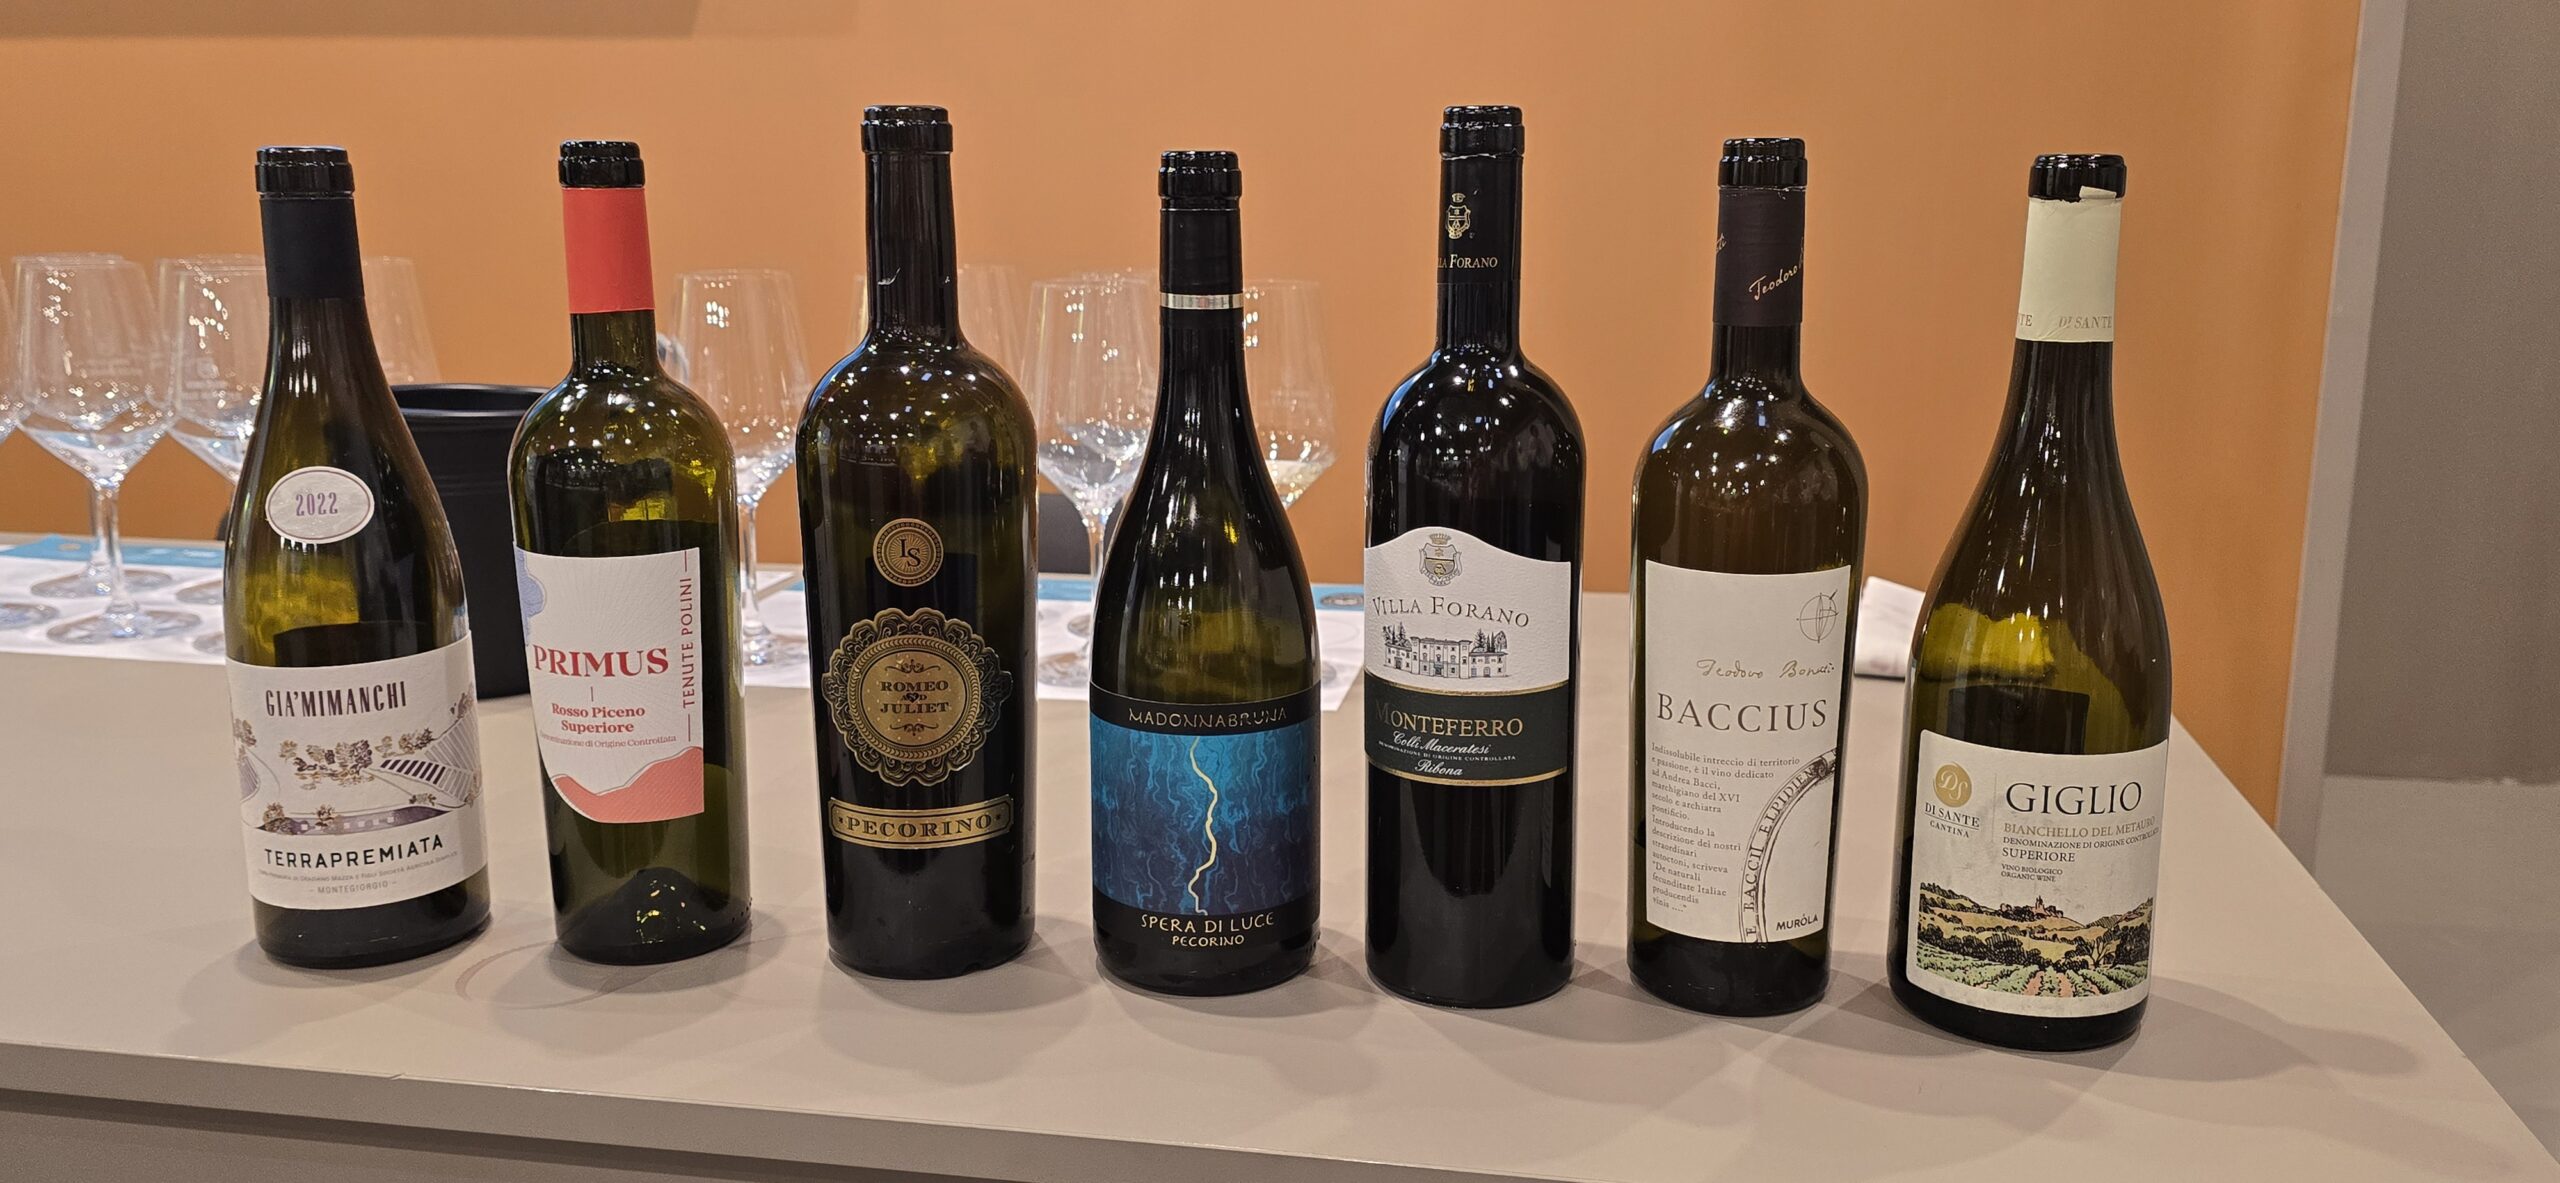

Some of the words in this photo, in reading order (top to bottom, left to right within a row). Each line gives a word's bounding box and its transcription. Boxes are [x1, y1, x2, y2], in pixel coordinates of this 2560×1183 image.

[1449, 254, 1498, 268] FORANO
[295, 491, 339, 517] 2022
[899, 538, 921, 567] IS
[680, 577, 693, 635] POLINI
[1372, 596, 1422, 617] VILLA
[1430, 596, 1529, 628] FORANO
[533, 644, 669, 678] PRIMUS
[681, 641, 695, 708] TENUTE
[880, 680, 949, 692] ROMEO
[265, 680, 408, 718] GIA'MIMANCHI
[880, 702, 950, 714] JULIET
[552, 703, 589, 718] Rosso
[592, 706, 646, 718] Piceno
[1128, 707, 1288, 728] MADONNABRUNA
[1375, 701, 1524, 737] MONTEFERRO
[1656, 693, 1828, 733] BACCIUS
[561, 720, 635, 735] Superiore
[627, 735, 677, 747] Controllata
[1393, 730, 1422, 749] Colli
[1420, 738, 1492, 755] Maceratesi
[1652, 742, 1701, 762] Indissolubile
[1703, 754, 1744, 766] intreccio
[1747, 758, 1757, 767] di
[1759, 757, 1800, 767] territorio
[1414, 759, 1463, 776] Ribona
[1657, 758, 1692, 773] passione,
[1702, 767, 1708, 775] il
[1711, 768, 1732, 778] vino
[1734, 770, 1774, 779] dedicato
[1652, 768, 1660, 777] ad
[1661, 770, 1690, 785] Andrea
[1693, 777, 1721, 790] Bacci,
[1652, 781, 1700, 799] marchigiano
[1702, 791, 1716, 801] del
[1719, 792, 1741, 803] XVI
[2005, 781, 2142, 815] GIGLIO
[1682, 801, 1722, 813] archiatra
[1925, 802, 1936, 815] DI
[1938, 807, 1980, 828] SANTE
[847, 813, 993, 838] PECORINO
[1652, 814, 1704, 835] Introducendo
[1707, 828, 1715, 837] la
[1929, 820, 1969, 839] CANTINA
[2004, 822, 2089, 838] BIANCHELLO
[2091, 826, 2113, 838] DEL
[2115, 815, 2156, 836] METAURO
[1652, 826, 1695, 846] descrizione
[1697, 839, 1711, 849] dei
[1713, 842, 1741, 851] nostri
[1652, 839, 1697, 858] straordinari
[2003, 836, 2081, 849] DENOMINAZIONE
[2094, 839, 2125, 849] ORIGINE
[263, 833, 443, 869] TERRAPREMIATA
[1652, 850, 1690, 868] autoctoni,
[1692, 862, 1728, 873] scriveva
[2002, 846, 2076, 862] SUPERIORE
[1668, 868, 1701, 881] naturali
[2000, 870, 2036, 881] ORGANIC
[2037, 874, 2057, 882] WINE
[2001, 862, 2021, 872] VINO
[2022, 866, 2064, 875] BIOLOGICO
[317, 880, 389, 894] MONTEGIORGIO
[1697, 884, 1727, 897] Italiae
[1141, 914, 1197, 934] SPERA
[1204, 919, 1223, 934] DI
[1230, 911, 1275, 932] LUCE
[1172, 934, 1245, 947] PECORINO
